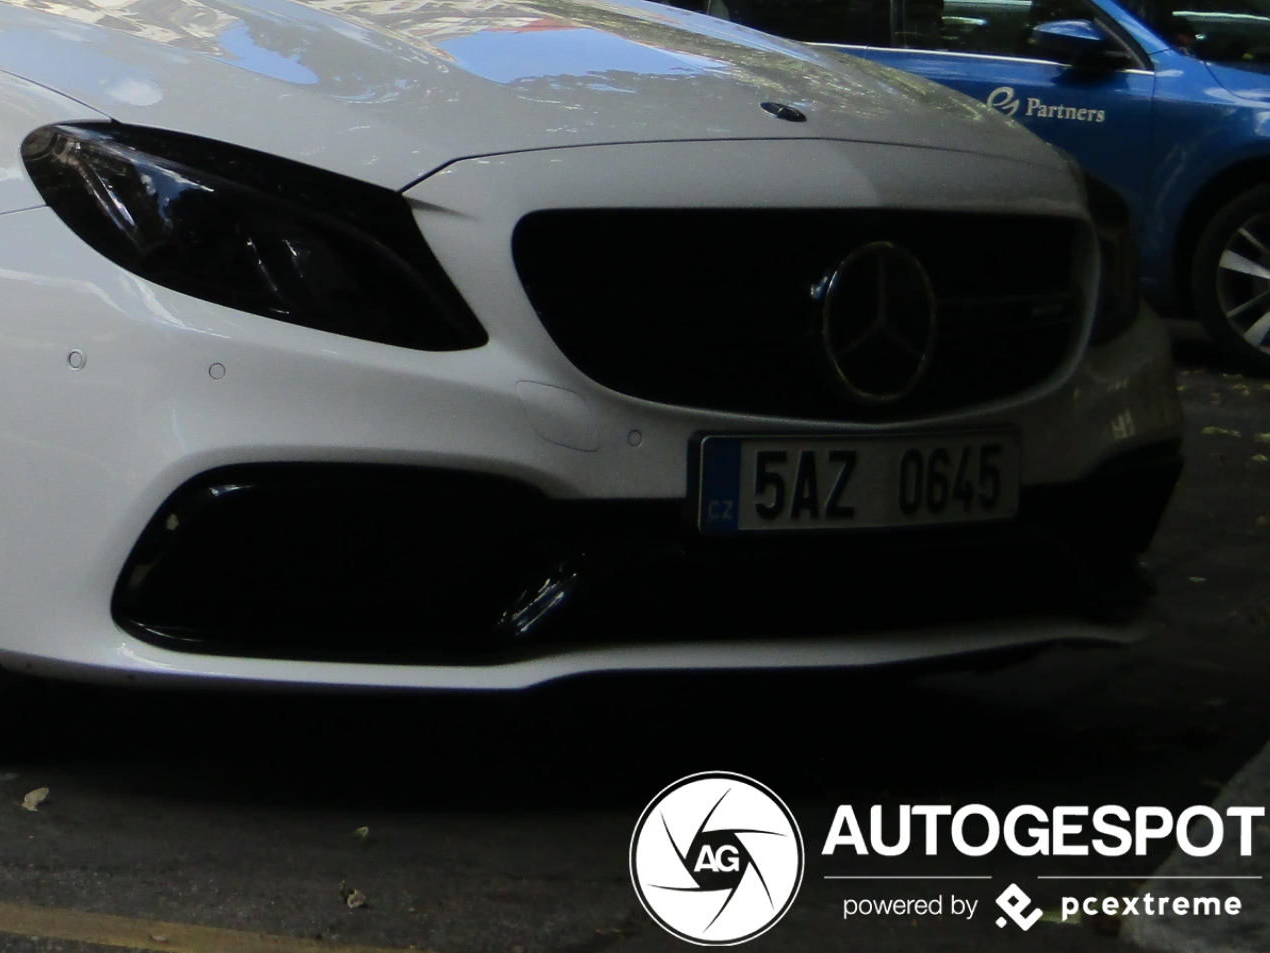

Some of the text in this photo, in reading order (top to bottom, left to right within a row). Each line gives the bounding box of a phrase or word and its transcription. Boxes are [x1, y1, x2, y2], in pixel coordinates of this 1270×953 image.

[1025, 97, 1106, 123] Partners
[752, 443, 1002, 521] 5AZ 0645
[706, 500, 734, 520] CZ
